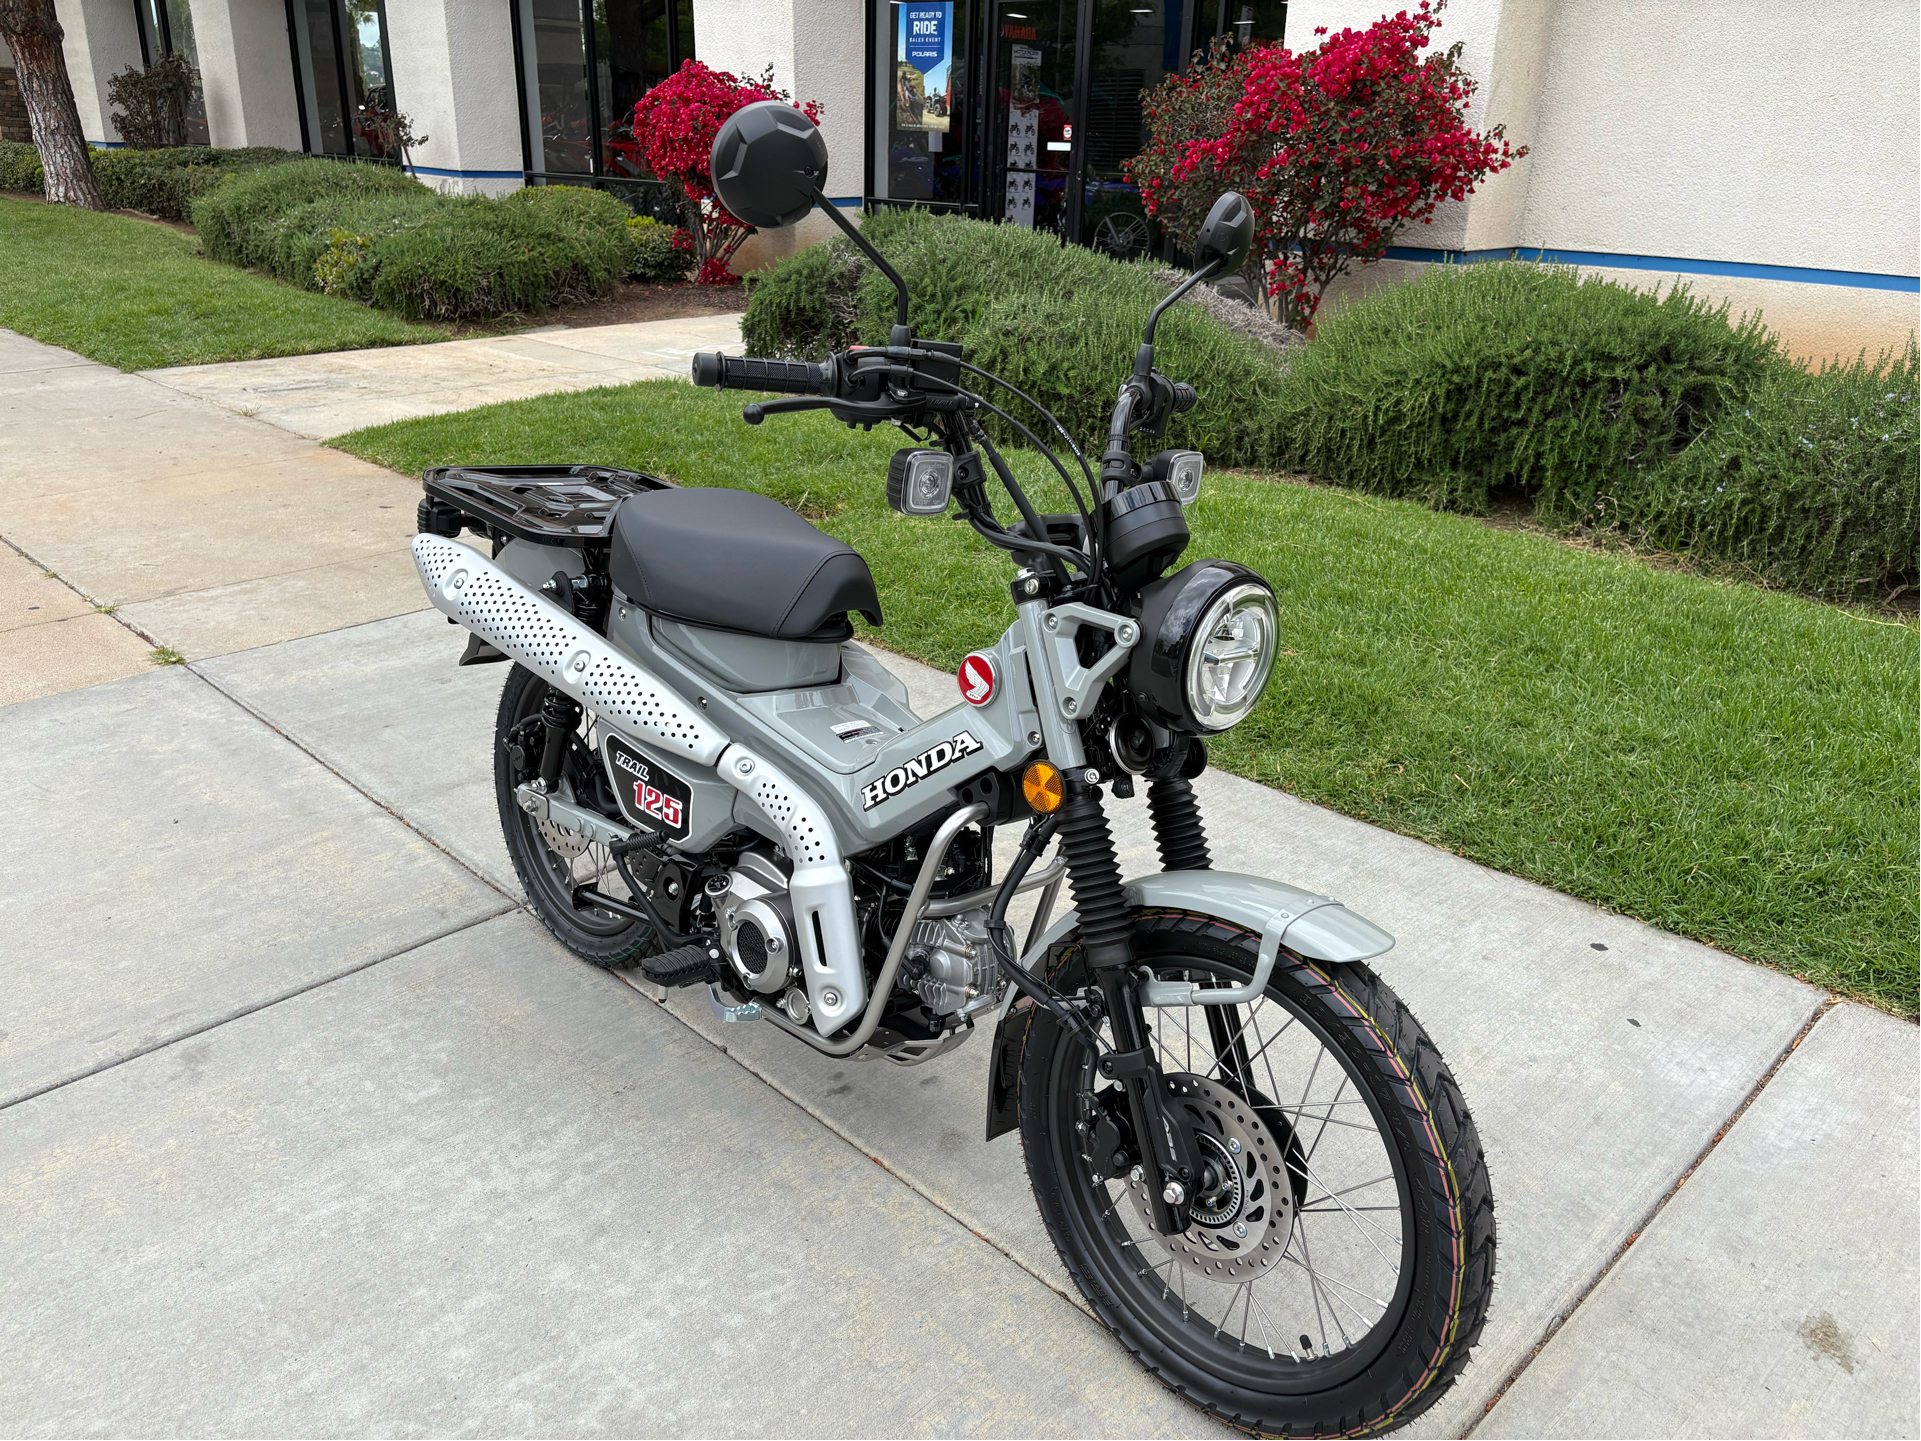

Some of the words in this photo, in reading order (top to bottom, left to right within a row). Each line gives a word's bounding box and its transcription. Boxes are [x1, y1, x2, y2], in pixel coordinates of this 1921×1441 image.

[910, 11, 919, 19] GET
[919, 11, 935, 19] READY
[935, 11, 943, 19] TO
[913, 20, 938, 35] RIDE
[1004, 24, 1037, 40] YAMAHA
[615, 750, 650, 782] TRAIL
[861, 729, 984, 812] HONDA
[633, 780, 683, 829] 125
